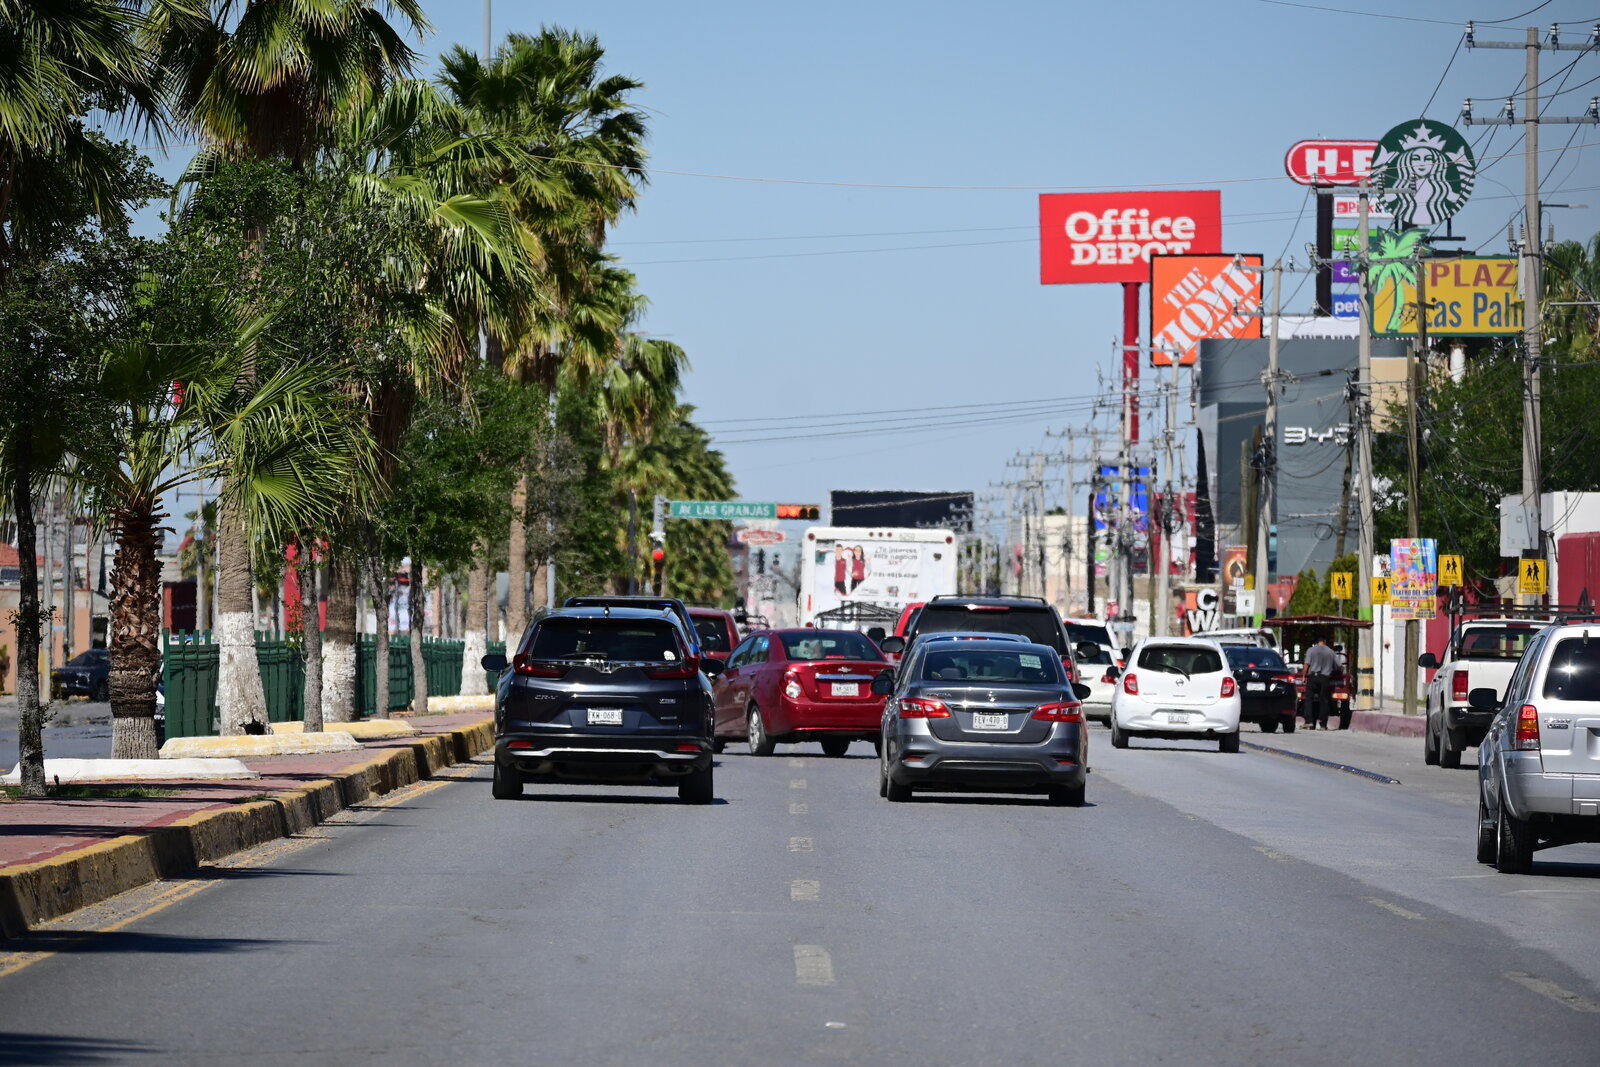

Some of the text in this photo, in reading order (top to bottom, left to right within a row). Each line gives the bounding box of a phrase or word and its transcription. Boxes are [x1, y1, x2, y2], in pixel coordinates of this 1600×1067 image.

[1348, 201, 1374, 213] Pik
[1065, 208, 1196, 241] Office
[1070, 241, 1192, 265] DEPOT
[1163, 267, 1209, 310] THE
[1153, 260, 1262, 363] HOME
[1426, 300, 1462, 328] as
[1284, 426, 1349, 443] BYD
[696, 505, 717, 515] LAS
[720, 505, 770, 517] GRANJAS
